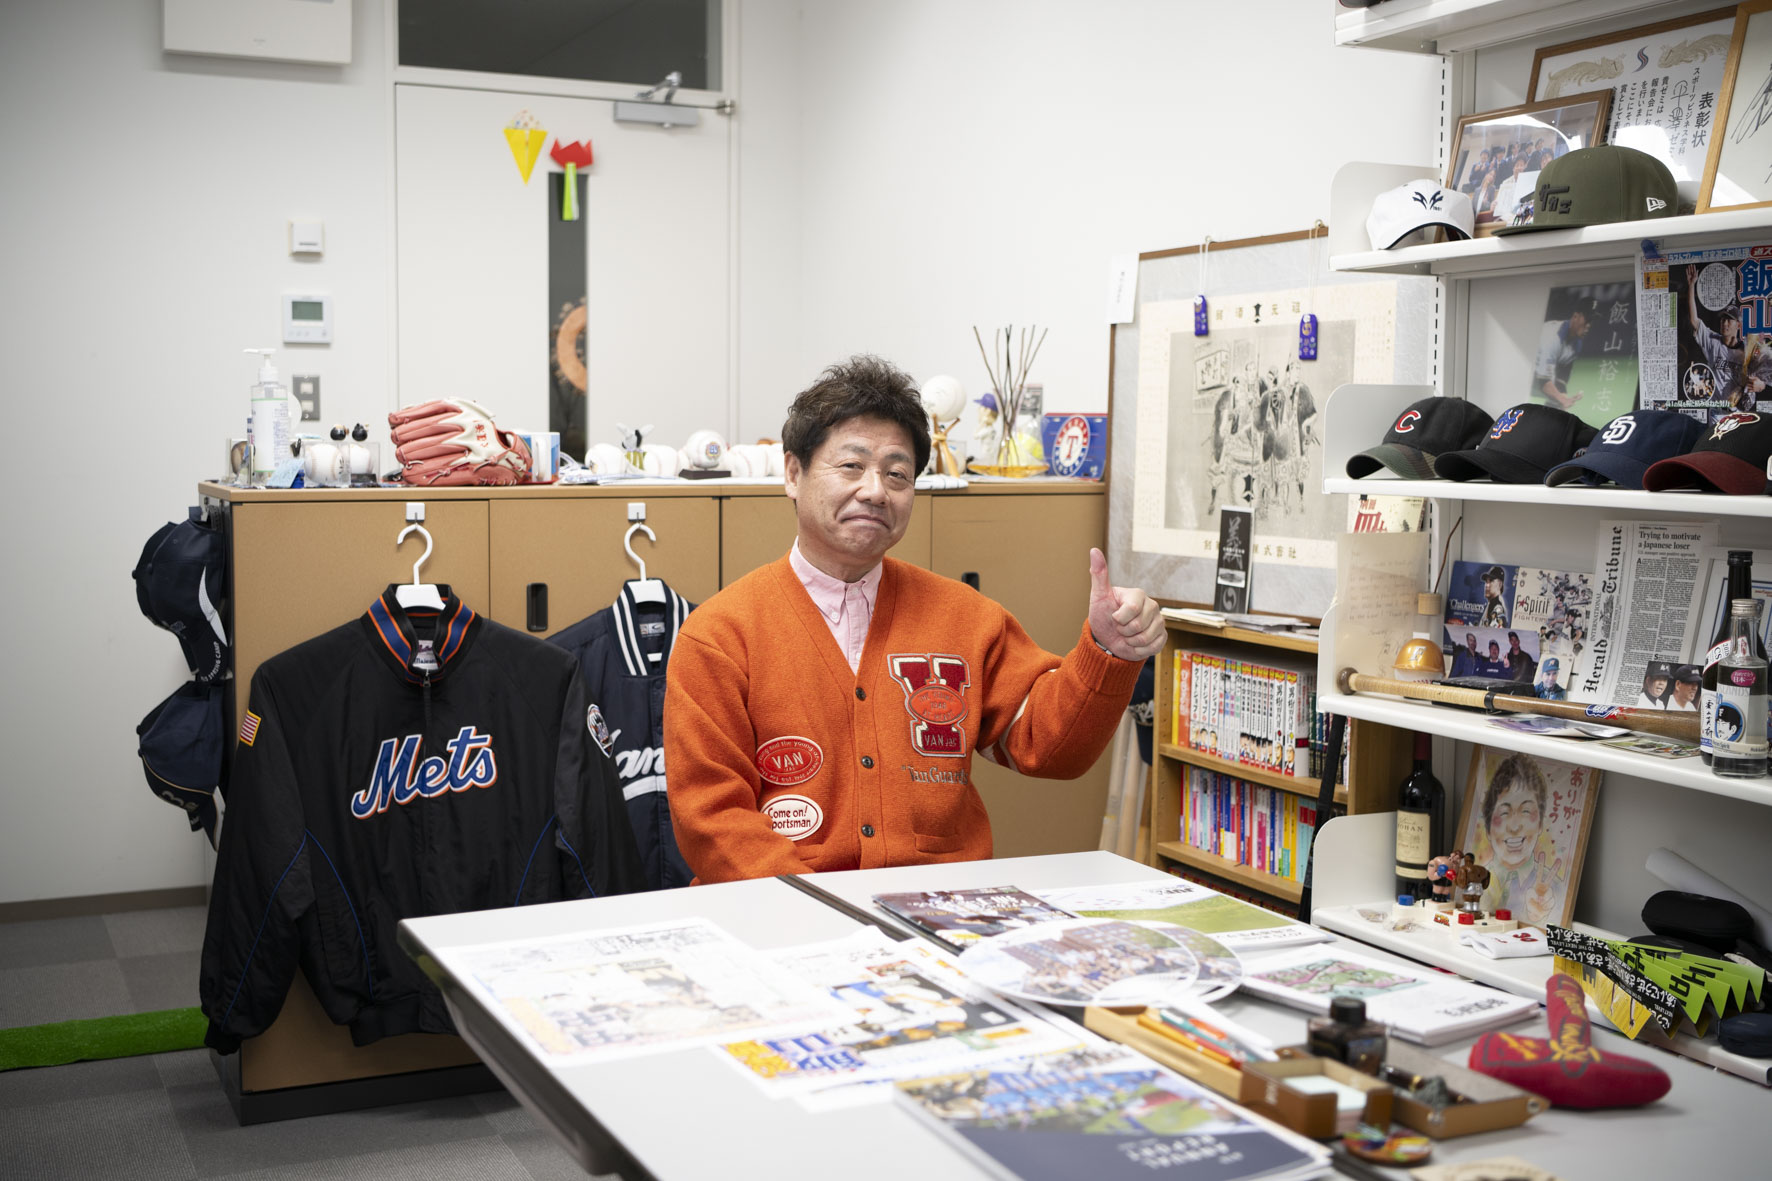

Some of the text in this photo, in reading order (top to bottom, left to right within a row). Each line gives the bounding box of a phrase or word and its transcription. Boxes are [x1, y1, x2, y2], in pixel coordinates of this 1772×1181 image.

[1678, 67, 1700, 155] スポーツビジネス学科
[1691, 91, 1715, 148] 表彰状
[1592, 300, 1630, 412] 飯山裕志
[1394, 409, 1421, 433] C
[1067, 435, 1080, 459] T
[1639, 531, 1701, 541] Trying to motivate
[1643, 541, 1672, 550] Japanese
[1673, 541, 1690, 550] loser
[1583, 639, 1608, 693] Herald
[1602, 525, 1623, 594] Tribune
[1590, 593, 1601, 642] INTERNATIONAL
[924, 734, 944, 747] VAN
[771, 751, 804, 769] VAN
[351, 725, 498, 820] Mets
[767, 805, 808, 819] Come on!
[771, 819, 811, 830] portsman
[1550, 939, 1565, 947] LEVEL
